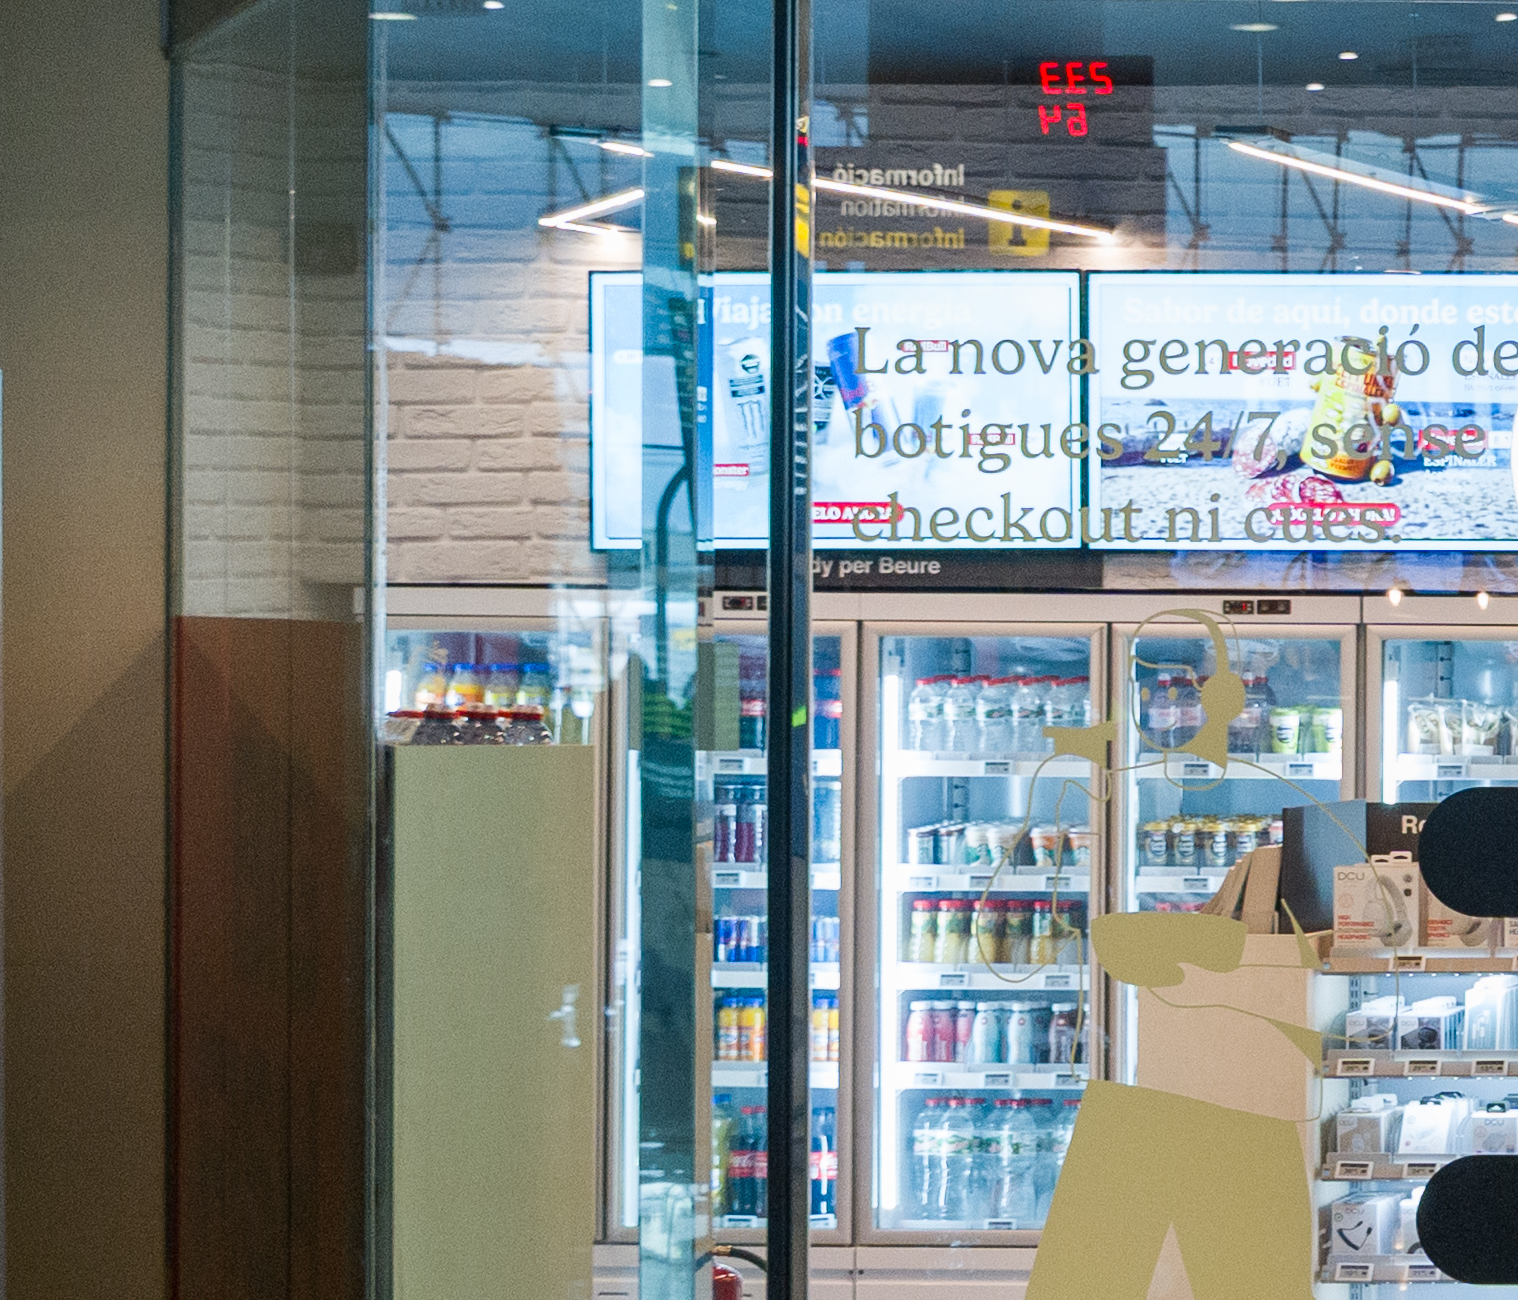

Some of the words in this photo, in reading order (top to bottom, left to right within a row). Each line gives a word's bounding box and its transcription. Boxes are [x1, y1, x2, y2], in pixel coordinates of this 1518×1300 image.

[1122, 298, 1217, 325] Sabor
[1226, 298, 1265, 325] de
[1359, 297, 1455, 325] donde
[853, 325, 929, 376] La
[948, 338, 1101, 376] nova
[1120, 323, 1431, 391] generació
[852, 408, 1124, 474] botigues
[1142, 409, 1289, 473] 24/7,
[1310, 421, 1487, 462] sense
[850, 492, 1154, 543] checkout
[1164, 492, 1221, 543] ni
[1243, 504, 1402, 543] cues.
[840, 559, 873, 578] per
[879, 557, 943, 574] Beure
[1337, 871, 1365, 881] DCU
